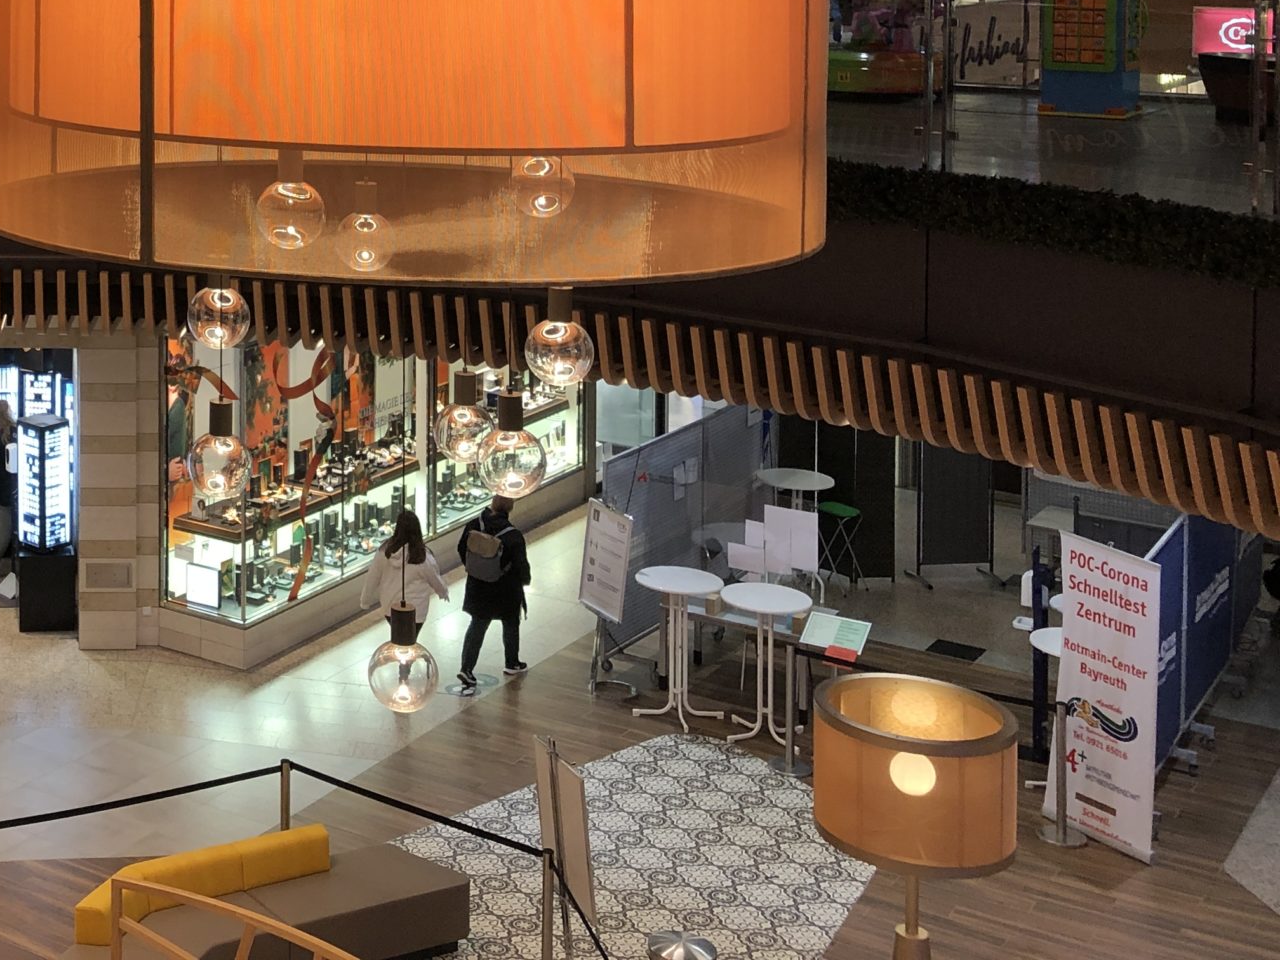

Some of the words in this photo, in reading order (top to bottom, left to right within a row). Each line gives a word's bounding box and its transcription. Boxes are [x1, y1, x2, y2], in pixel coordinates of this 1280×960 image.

[1070, 549, 1149, 592] POC-Corona
[1068, 574, 1147, 617] Schnelltest
[1076, 602, 1136, 638] Zentrum
[1063, 637, 1148, 680] Rotmain-Center
[1079, 662, 1128, 692] Bayreuth
